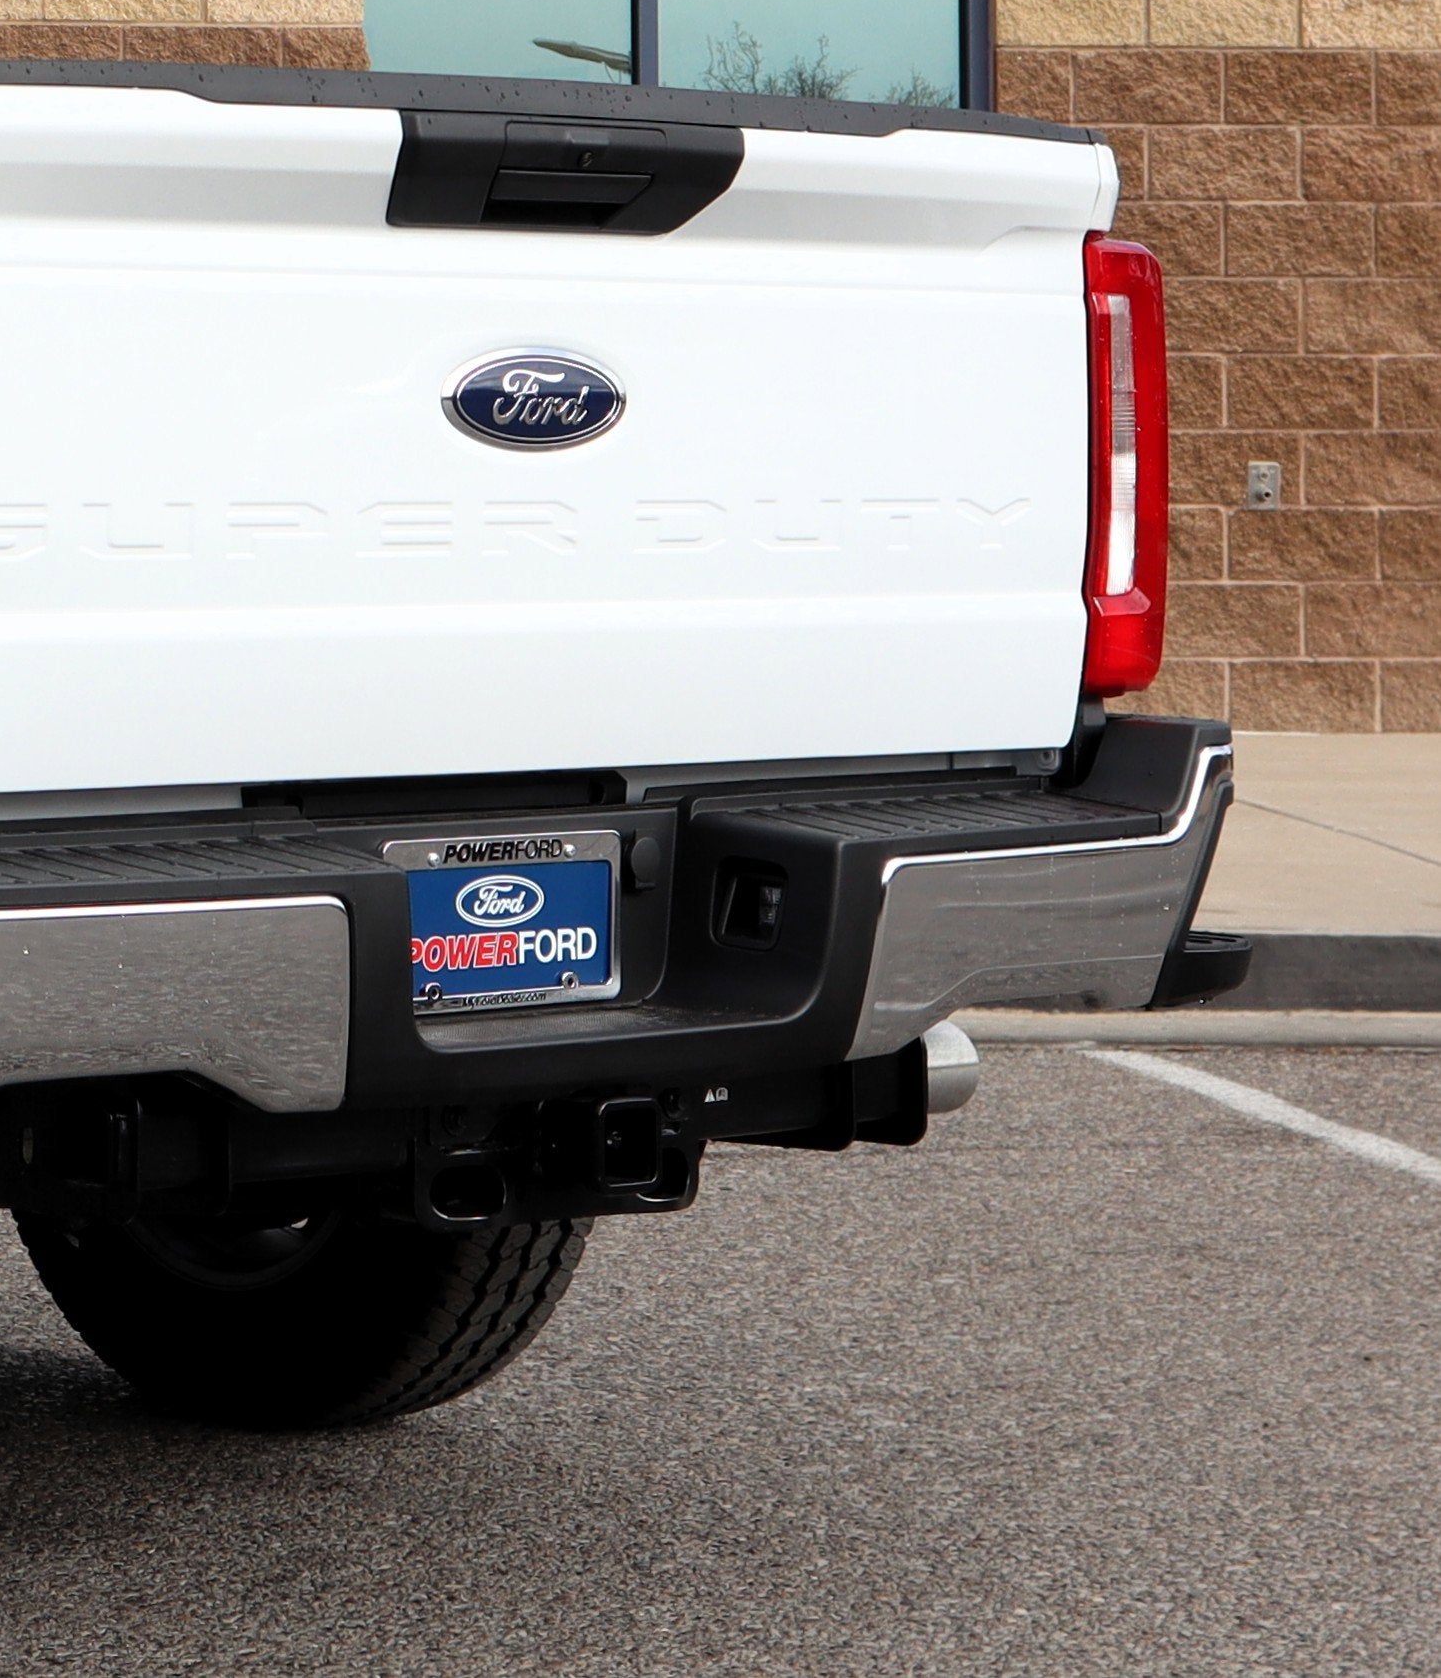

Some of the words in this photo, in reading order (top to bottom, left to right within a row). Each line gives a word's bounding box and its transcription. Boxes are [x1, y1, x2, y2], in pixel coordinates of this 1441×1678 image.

[492, 368, 591, 426] Ford
[631, 496, 1033, 556] DUTY
[443, 838, 565, 865] POWERFORD
[473, 884, 527, 916] Ford
